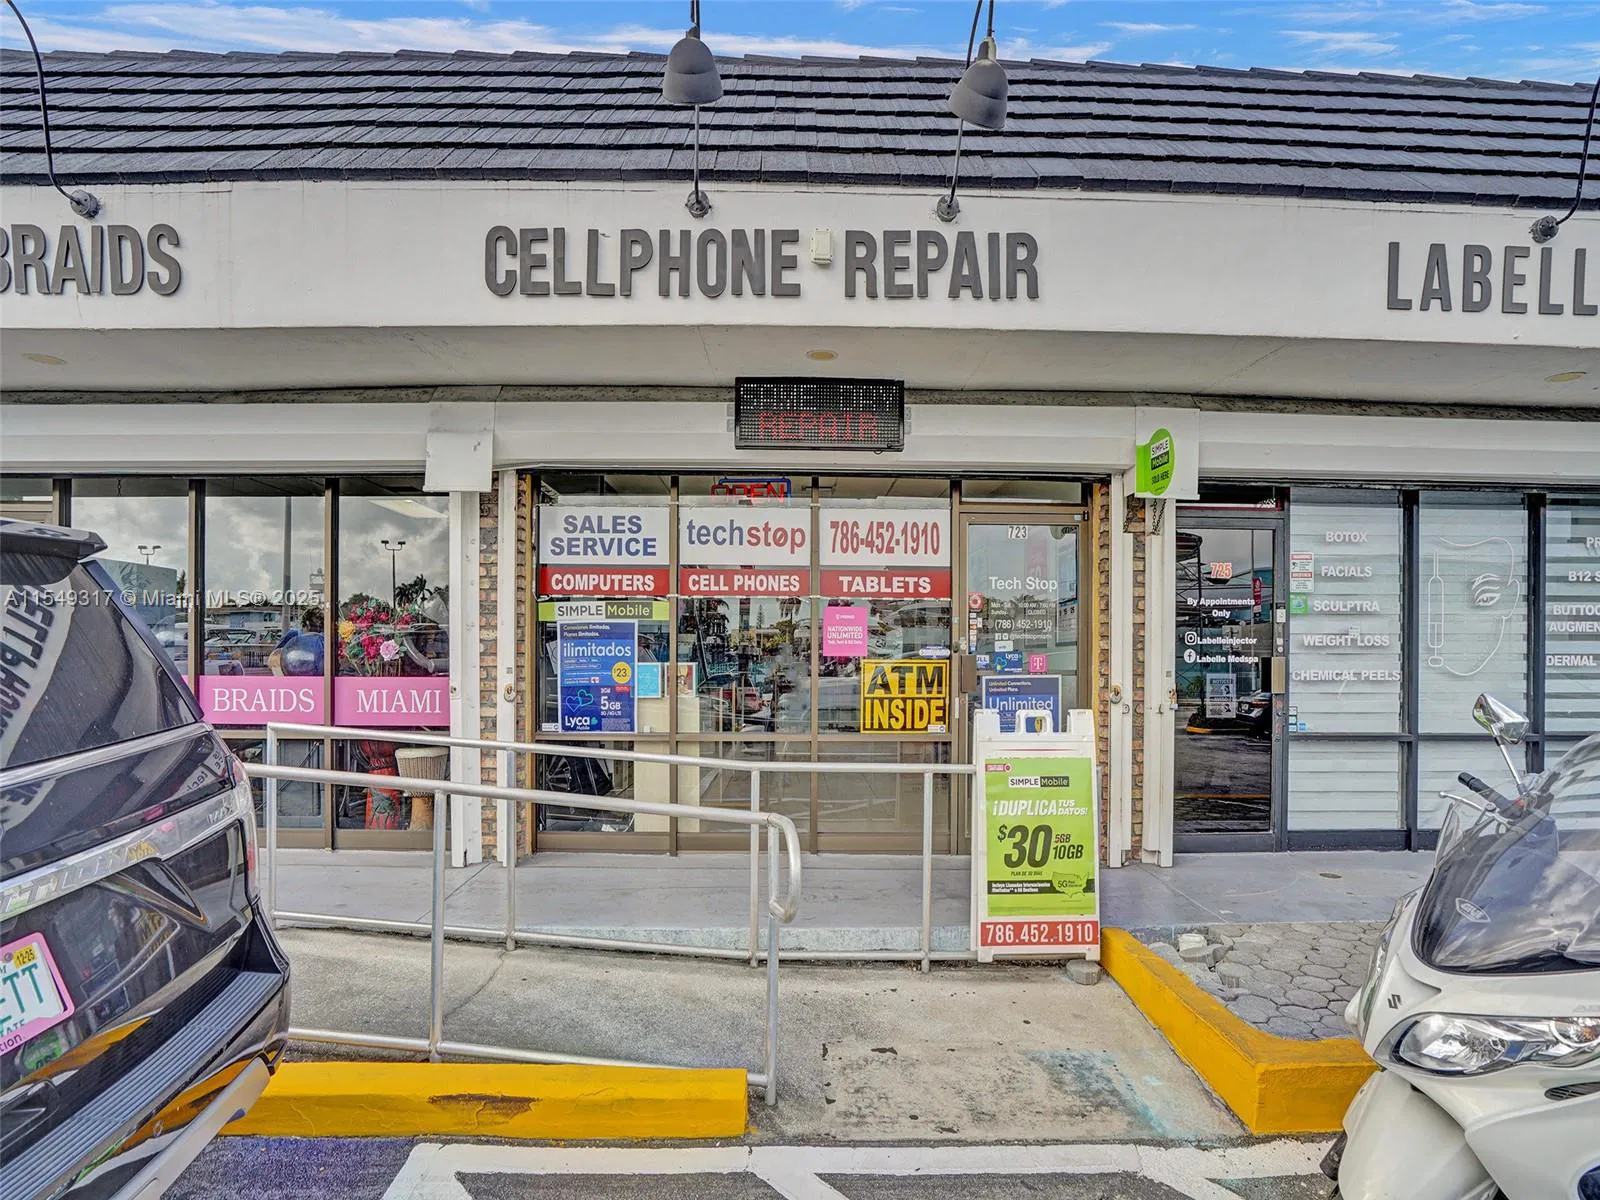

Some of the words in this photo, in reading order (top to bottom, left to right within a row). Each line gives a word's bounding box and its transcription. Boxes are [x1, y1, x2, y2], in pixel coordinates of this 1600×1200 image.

[485, 226, 801, 298] CELLPHONE
[845, 229, 1039, 300] REPAIR
[1387, 241, 1599, 316] LABELL
[760, 412, 878, 441] REPAIR
[563, 515, 642, 535] SALES
[1008, 526, 1027, 539] 723
[830, 520, 940, 556] 786-452-1910
[1325, 530, 1368, 544] BOTOX
[550, 537, 657, 557] SERVICE
[1210, 562, 1233, 579] 725
[1321, 565, 1373, 578] FACIALS
[1568, 571, 1592, 582] B12
[551, 573, 655, 593] COMPUTERS
[688, 574, 728, 592] CELL
[733, 574, 800, 592] PHONES
[839, 575, 932, 595] TABLETS
[989, 577, 1021, 589] Tech
[1025, 577, 1058, 592] Stop
[1187, 598, 1198, 607] By
[1200, 598, 1255, 607] Appointments
[1313, 600, 1380, 612] SCULPTRA
[557, 605, 603, 617] SIMPLE
[607, 604, 650, 616] Mobile
[1212, 609, 1231, 618] Only
[994, 619, 1015, 632] (786)
[1017, 619, 1052, 629] 452-1910
[1303, 635, 1352, 646] WEIGHT
[1357, 635, 1390, 646] LOSS
[563, 642, 632, 657] ilimitados
[1196, 655, 1226, 663] Labelle
[1228, 655, 1259, 665] Medspa
[1545, 655, 1597, 667] DERMAL
[867, 666, 944, 694] ATM
[1292, 670, 1357, 681] CHEMICAL
[1361, 670, 1400, 681] PEELS
[213, 688, 315, 713] BRAIDS
[357, 689, 441, 713] MIAMI
[989, 696, 1054, 710] Unlimited
[865, 699, 945, 729] INSIDE
[565, 716, 590, 728] Lyca
[1010, 778, 1039, 786] SIMPLE
[1041, 777, 1068, 786] Mobile
[997, 824, 1053, 868] $30
[1053, 845, 1084, 860] 10GB
[1058, 880, 1067, 888] 5G
[986, 924, 1093, 943] 786.452.1910
[16, 949, 35, 965] 12-25
